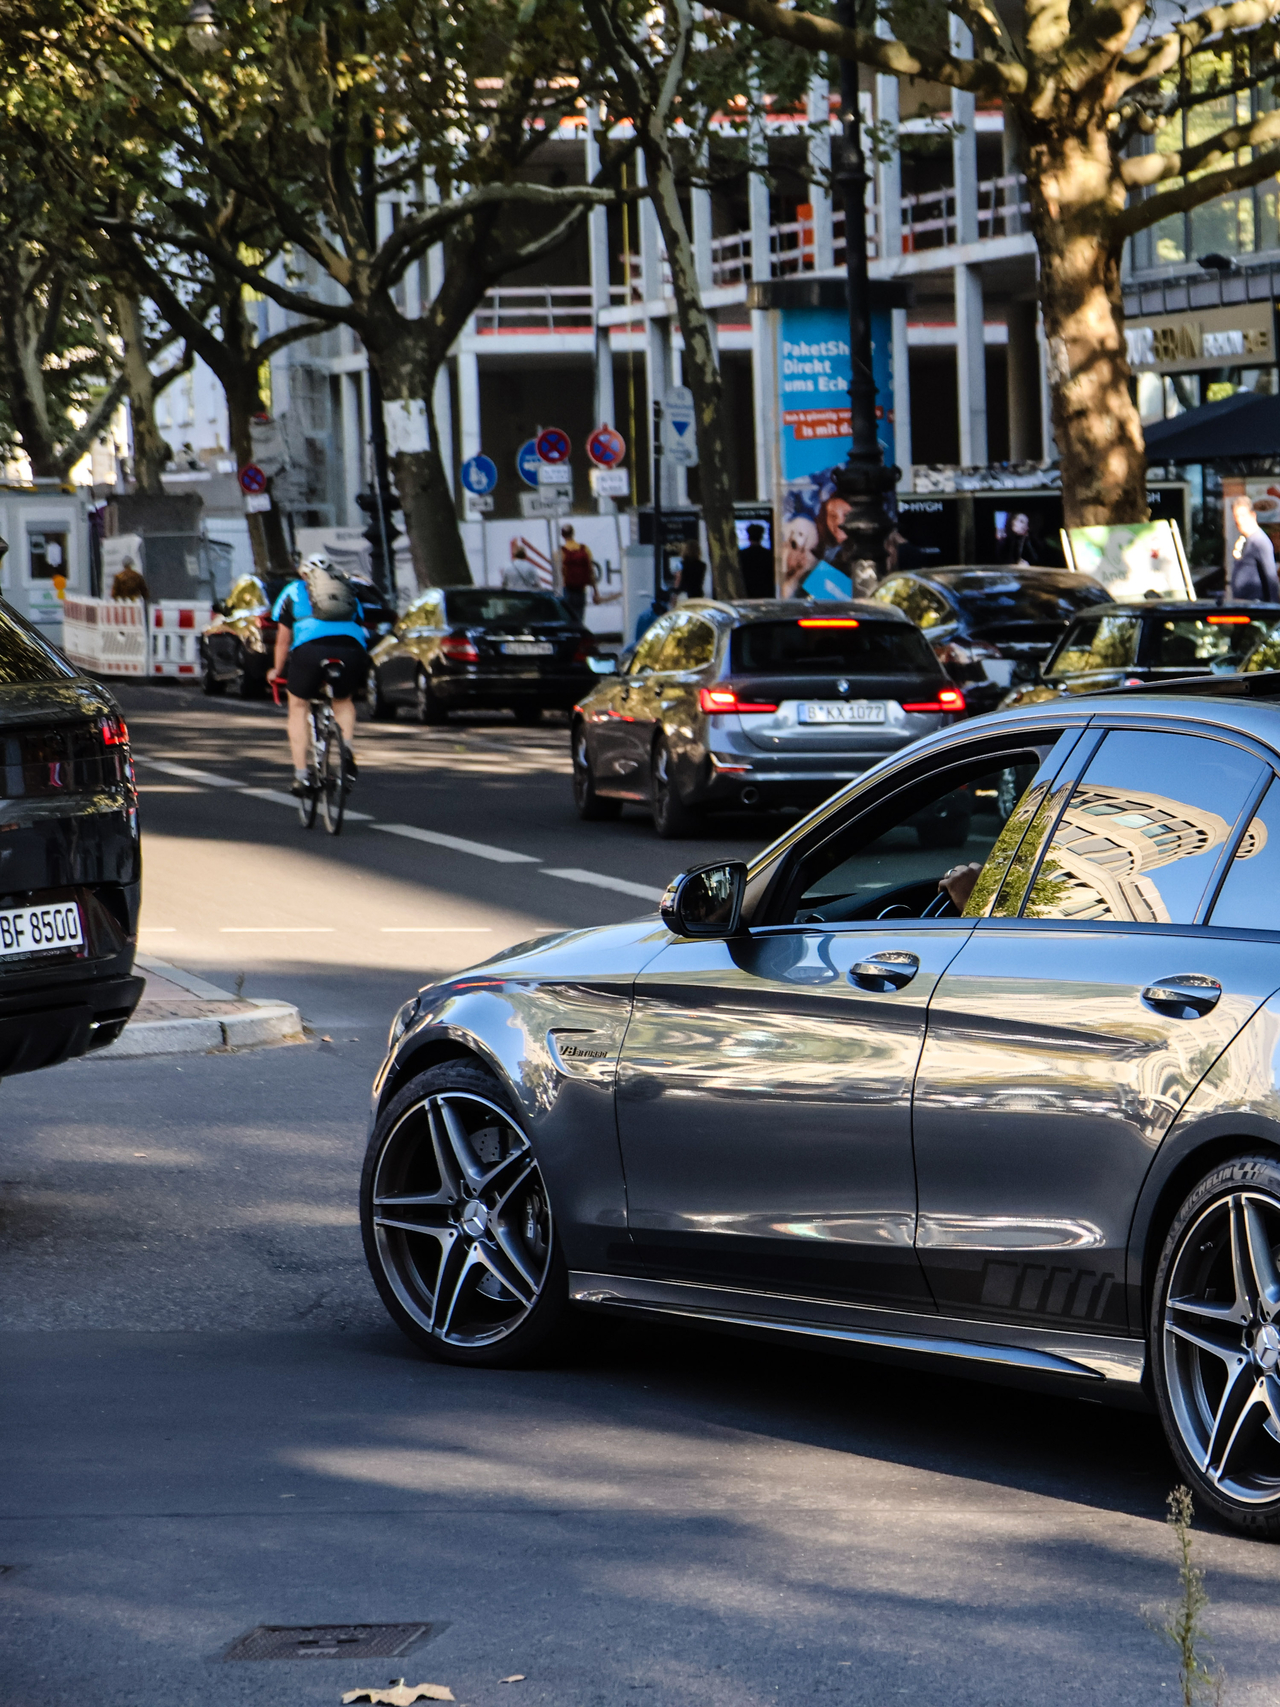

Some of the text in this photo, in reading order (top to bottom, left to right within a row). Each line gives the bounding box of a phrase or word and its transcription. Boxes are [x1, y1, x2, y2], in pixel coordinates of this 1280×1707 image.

[783, 358, 832, 375] Direkt
[784, 379, 815, 392] ums
[808, 705, 883, 720] B KX 1077
[0, 907, 78, 949] BF 8500
[1180, 1165, 1236, 1220] MICHELIN
